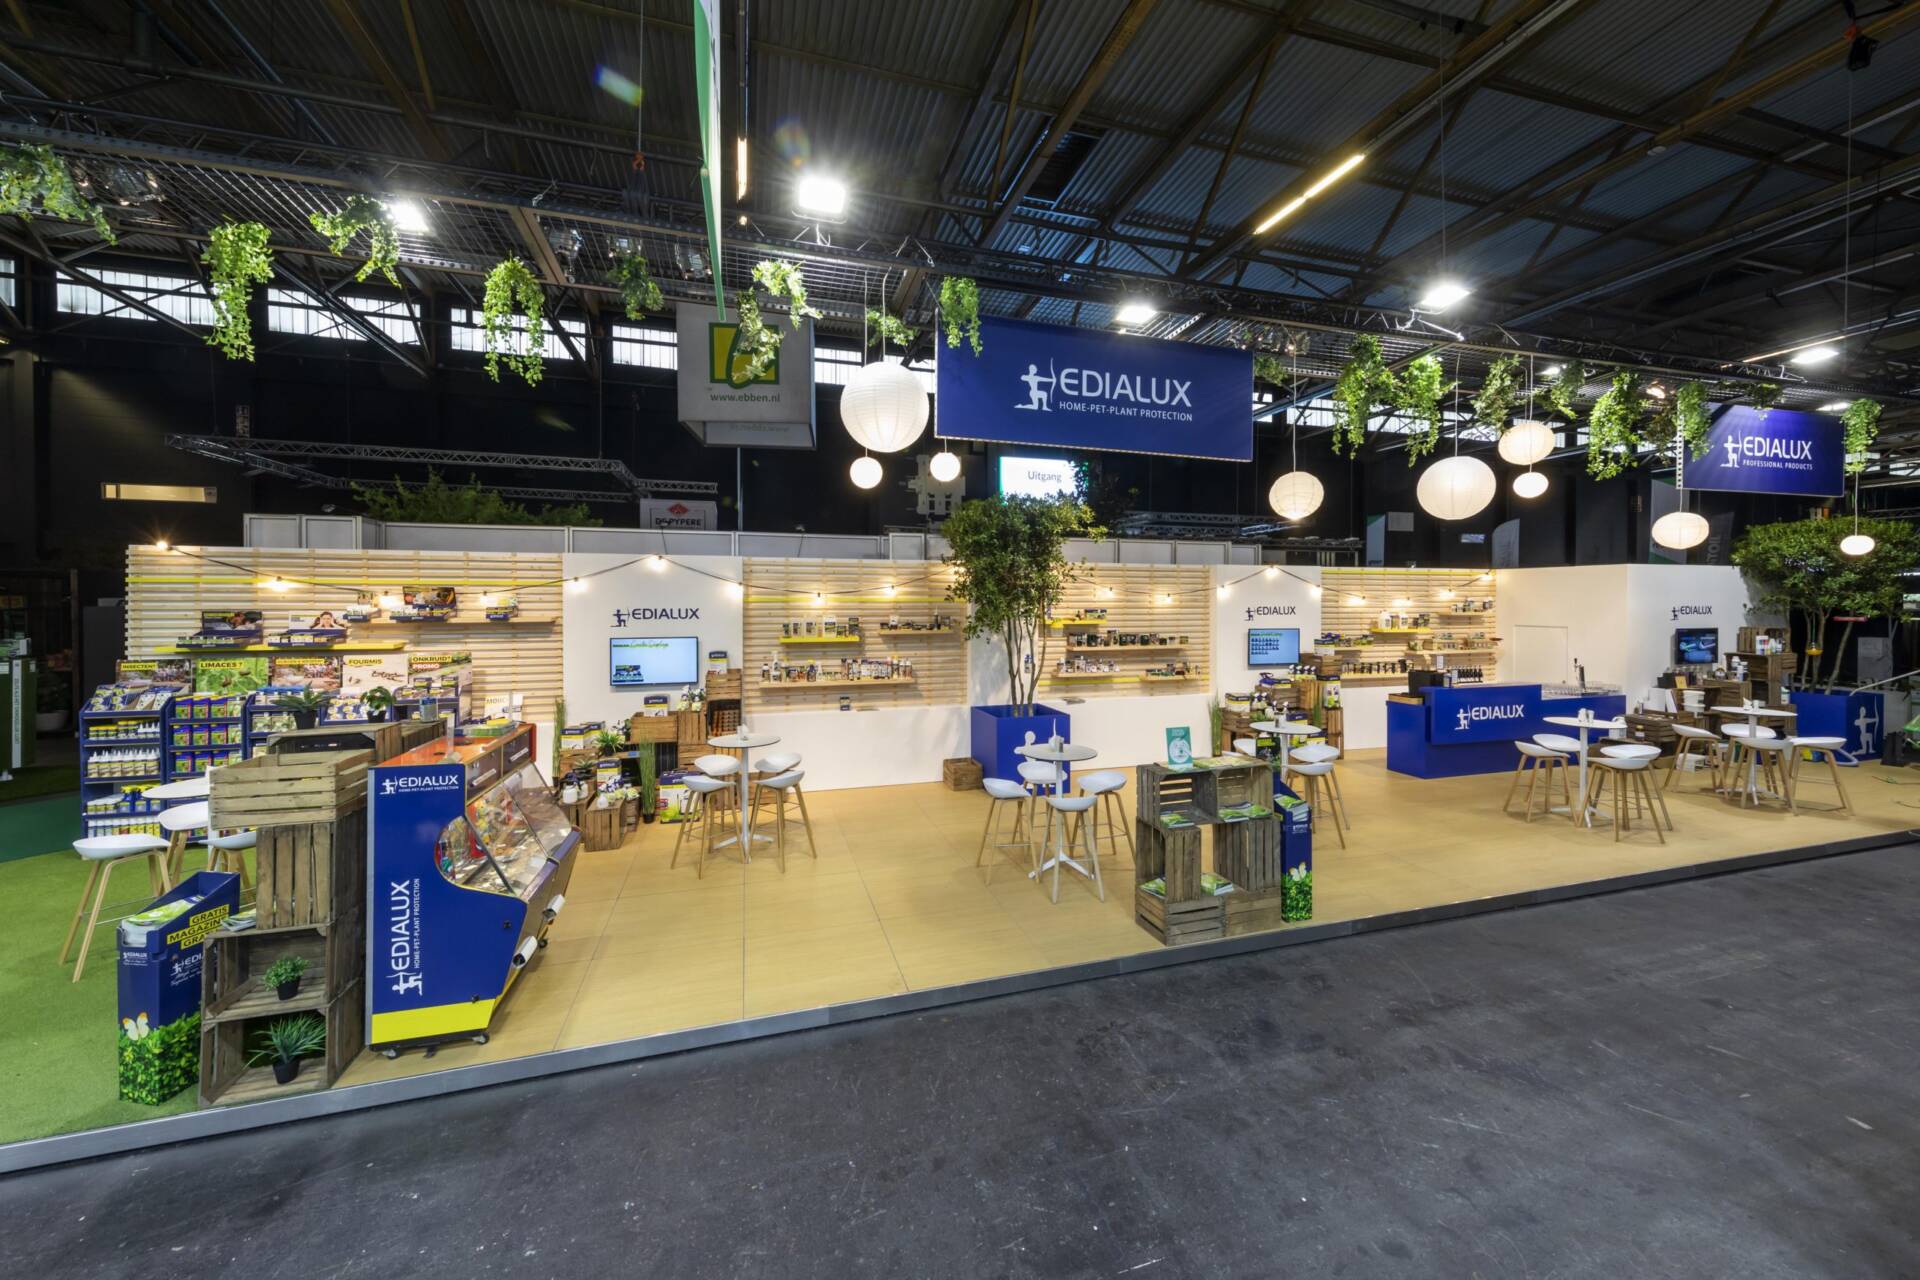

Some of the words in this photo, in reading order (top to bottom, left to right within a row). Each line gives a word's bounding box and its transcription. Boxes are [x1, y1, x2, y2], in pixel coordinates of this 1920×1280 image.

[1059, 368, 1192, 407] EDIALUX
[710, 393, 780, 403] www.ebben.nl
[1059, 401, 1138, 417] HOME-PET-PLANT
[1140, 409, 1193, 422] PROTECTION
[1743, 436, 1812, 460] EDIALUX
[1742, 459, 1783, 469] PROFESSIONAL
[1785, 462, 1813, 471] PRODUCTS
[1027, 470, 1062, 482] Uitgang
[631, 608, 700, 620] EDIALUX
[1256, 606, 1296, 616] EDIALUX
[1680, 605, 1713, 615] EDIALUX
[1471, 704, 1525, 721] EDIALUX
[398, 774, 459, 786] EDIALUX
[192, 908, 228, 924] GRATIS
[169, 917, 224, 942] MAGAZIN
[391, 880, 410, 970] EDIALUX
